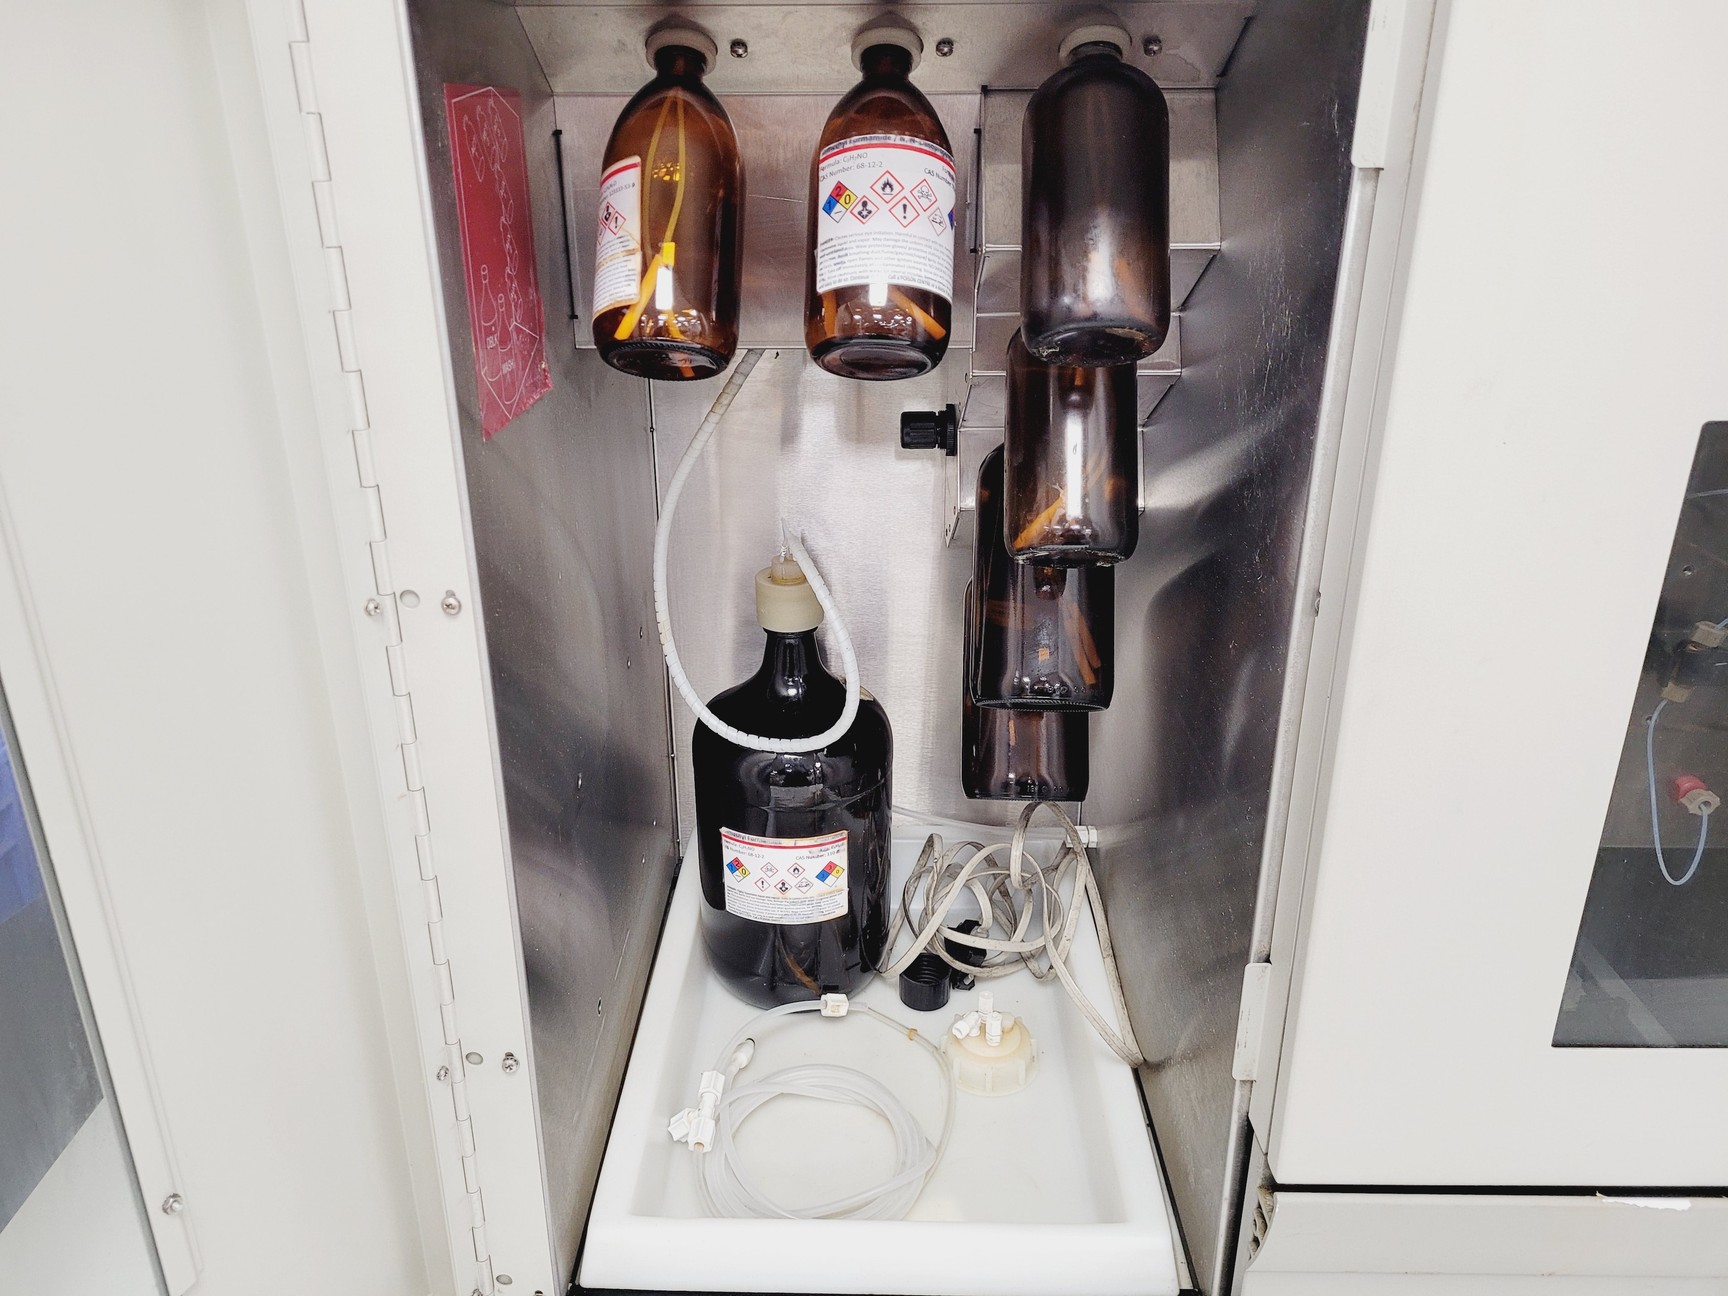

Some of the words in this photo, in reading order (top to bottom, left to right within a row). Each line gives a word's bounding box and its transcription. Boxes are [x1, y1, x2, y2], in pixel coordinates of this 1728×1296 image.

[924, 168, 935, 177] CAS
[836, 186, 842, 197] 2
[844, 194, 851, 205] 0
